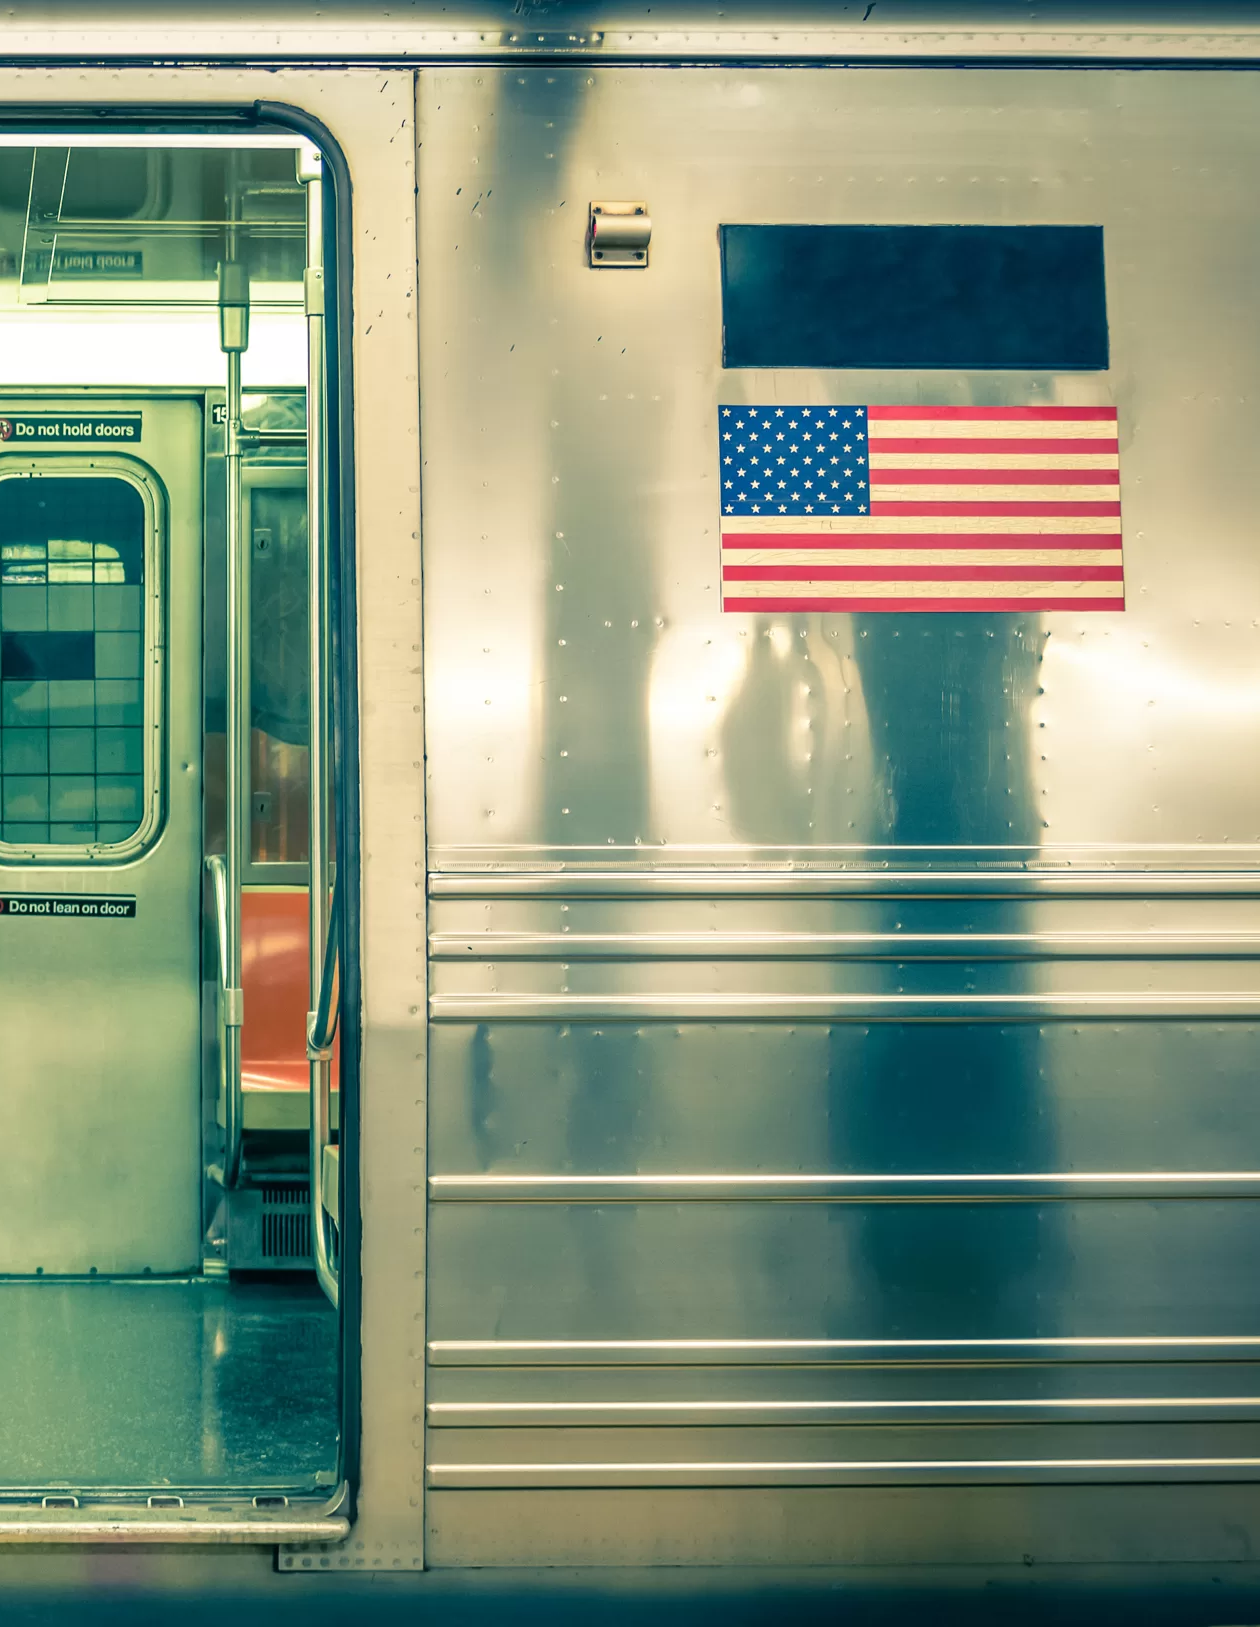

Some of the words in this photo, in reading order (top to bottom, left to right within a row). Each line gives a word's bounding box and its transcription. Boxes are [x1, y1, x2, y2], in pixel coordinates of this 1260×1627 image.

[15, 423, 35, 436] Do
[38, 423, 60, 436] not
[63, 423, 92, 436] hold
[95, 423, 134, 437] doors
[9, 900, 28, 913] Do
[29, 901, 50, 913] not
[53, 901, 80, 914] lean
[82, 904, 98, 914] on
[100, 902, 130, 915] door
